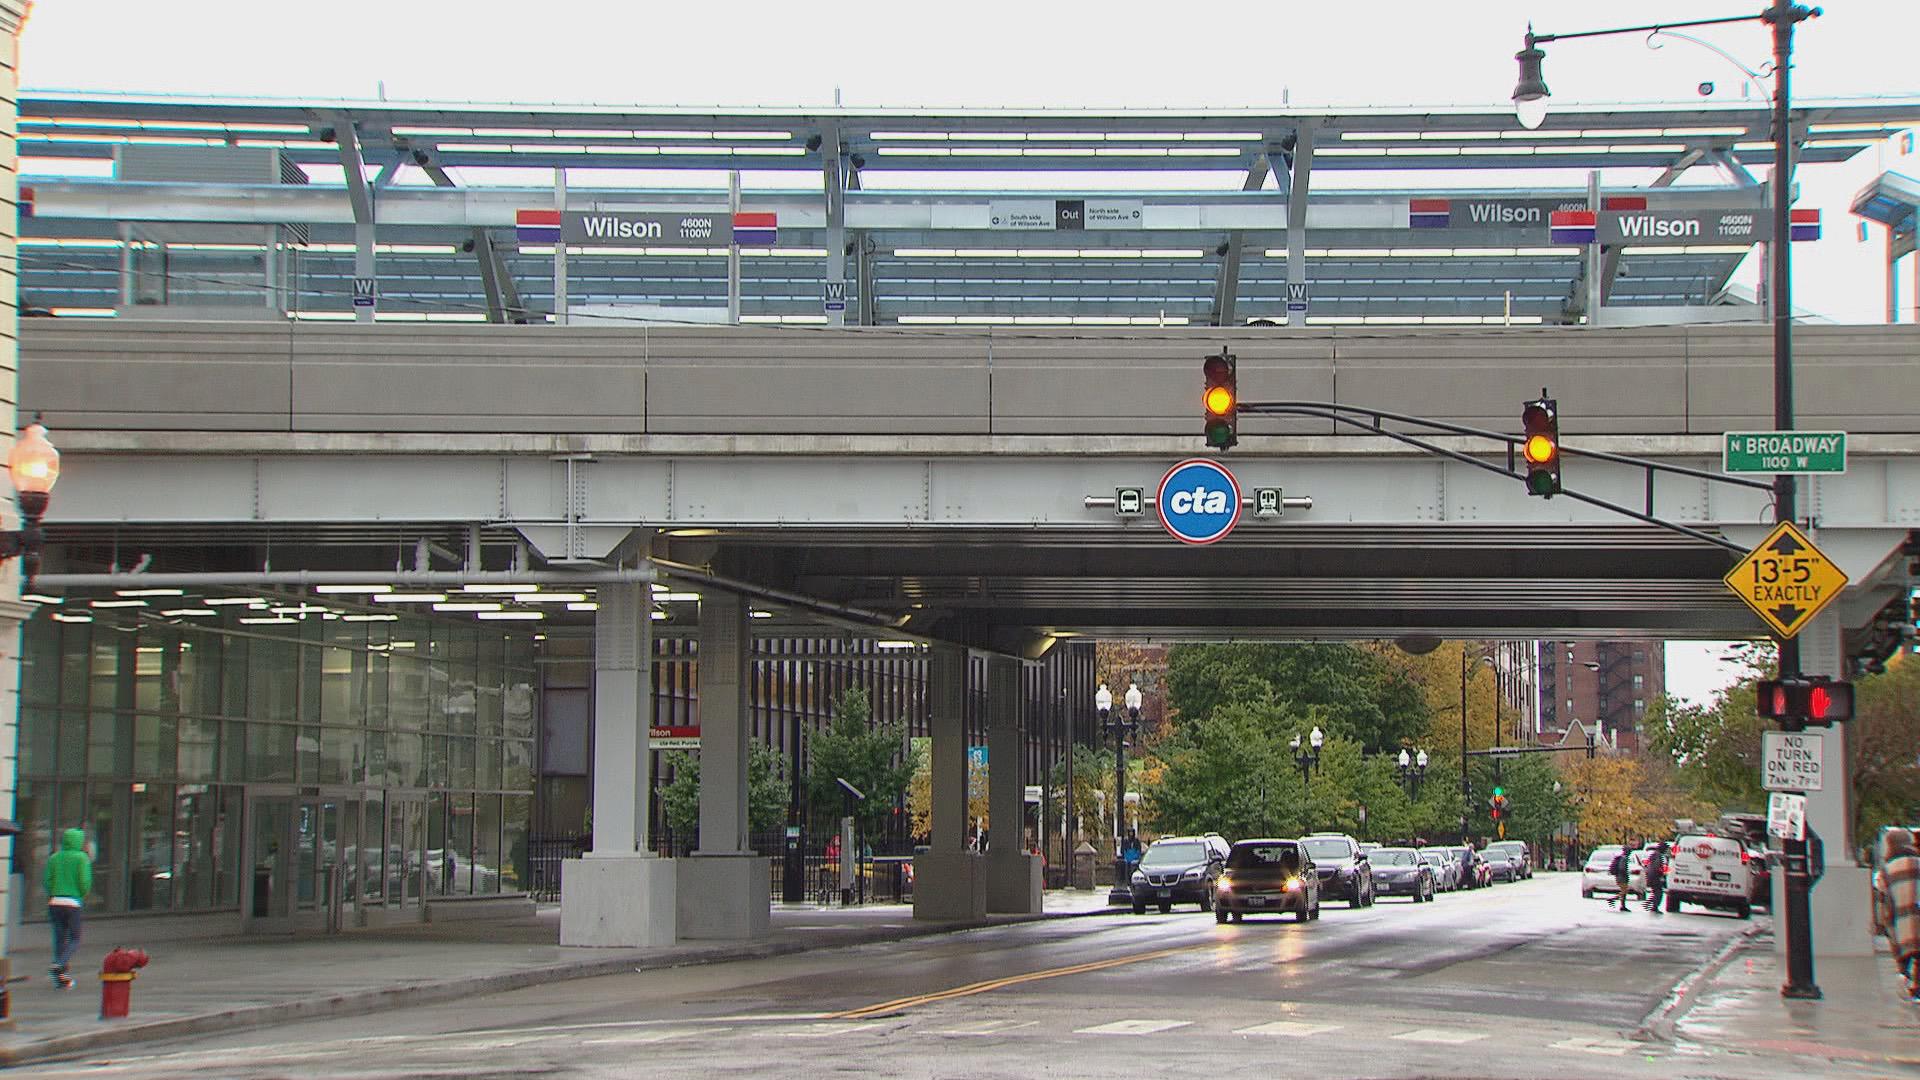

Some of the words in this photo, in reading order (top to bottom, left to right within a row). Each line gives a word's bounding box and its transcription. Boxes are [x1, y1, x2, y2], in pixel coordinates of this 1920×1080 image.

[1061, 209, 1079, 219] Out
[1469, 204, 1540, 223] Wilson
[1719, 215, 1752, 225] 4600N
[583, 216, 662, 238] Wilson
[680, 218, 711, 228] 4600N
[1618, 216, 1700, 236] Wilson
[679, 229, 711, 239] 1100W
[1718, 225, 1752, 235] 1100W
[355, 280, 372, 293] W
[827, 284, 843, 298] W
[1289, 284, 1305, 298] W
[1730, 440, 1740, 451] N
[1746, 437, 1839, 454] BROADWAY
[1762, 456, 1790, 468] 1100
[1796, 456, 1808, 468] W
[1753, 586, 1821, 601] EXACTLY
[1784, 737, 1804, 748] NO
[1776, 748, 1812, 760] TURN
[1767, 760, 1786, 771] ON
[1792, 761, 1820, 773] RED
